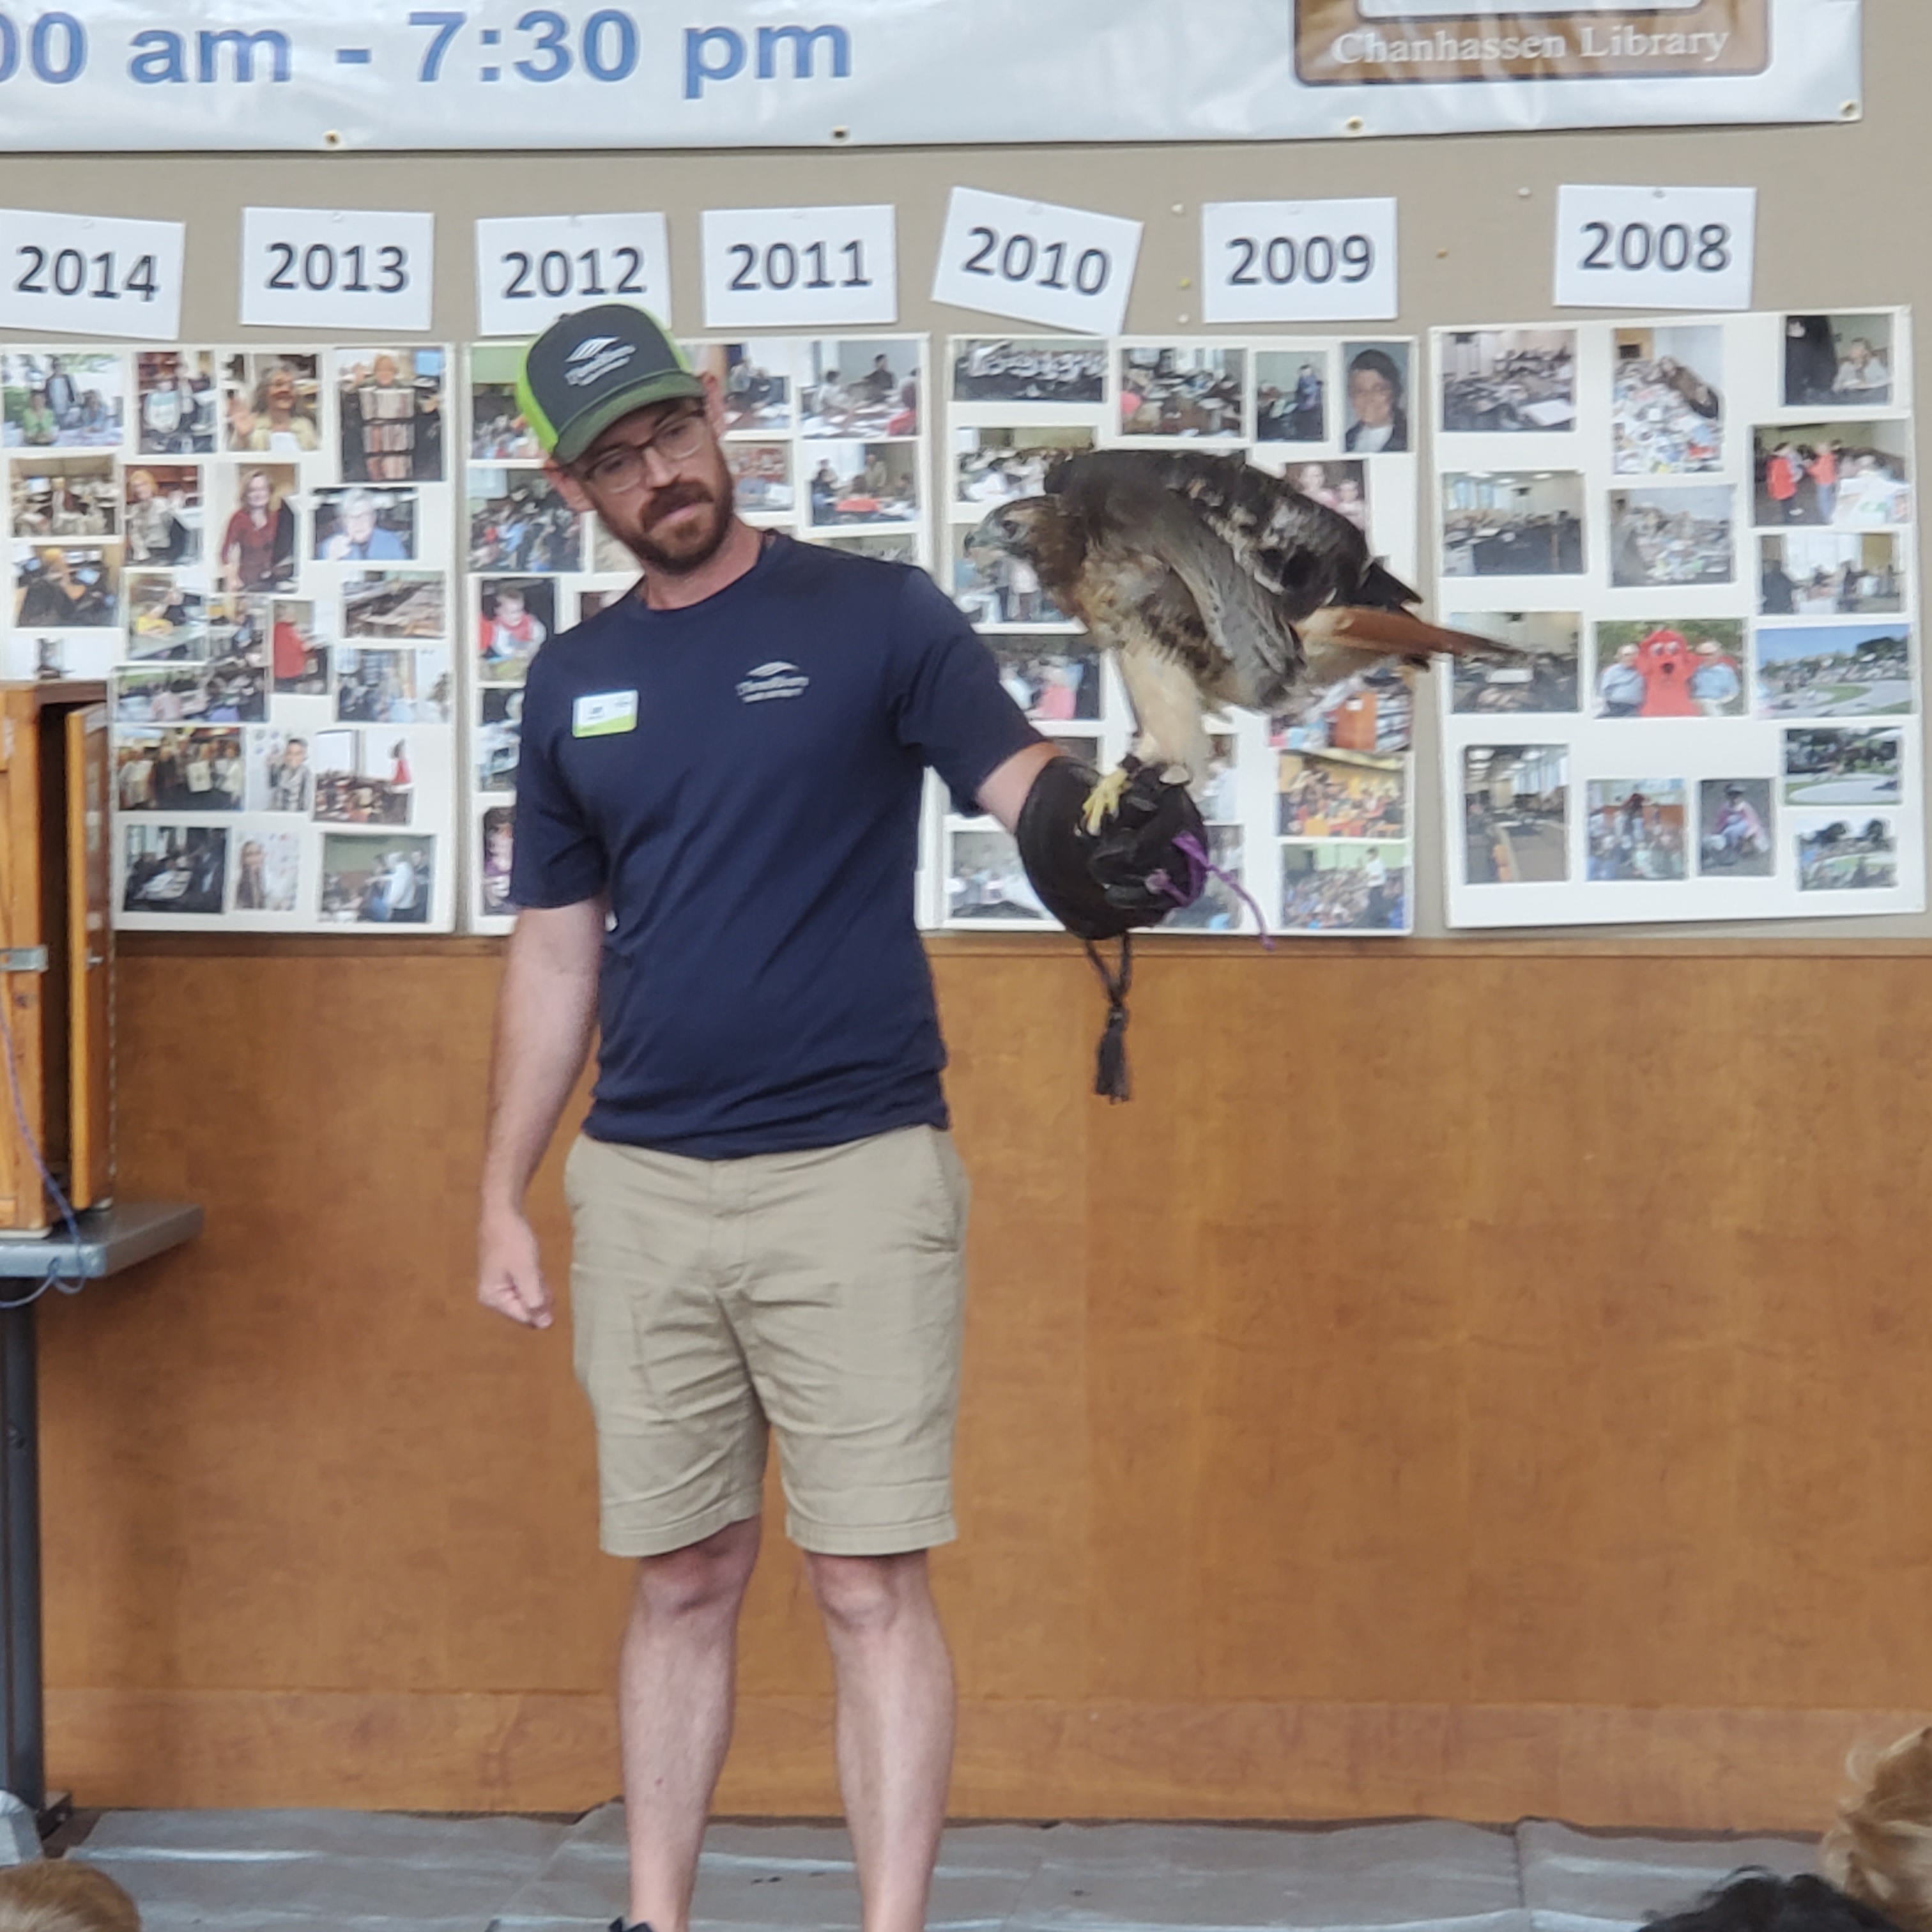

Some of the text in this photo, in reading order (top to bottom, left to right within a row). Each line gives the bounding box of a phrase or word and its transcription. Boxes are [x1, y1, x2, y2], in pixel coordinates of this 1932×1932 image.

[128, 29, 290, 84] am
[409, 10, 637, 84] 7:30
[684, 24, 851, 99] pm
[1331, 26, 1730, 65] Chanhassen Library
[16, 245, 158, 301] 2014
[266, 242, 408, 293] 2013
[503, 247, 645, 299] 2012
[728, 240, 871, 291] 2011
[963, 227, 1110, 296] 2010
[1228, 234, 1372, 286] 2009
[1581, 222, 1730, 272] 2008
